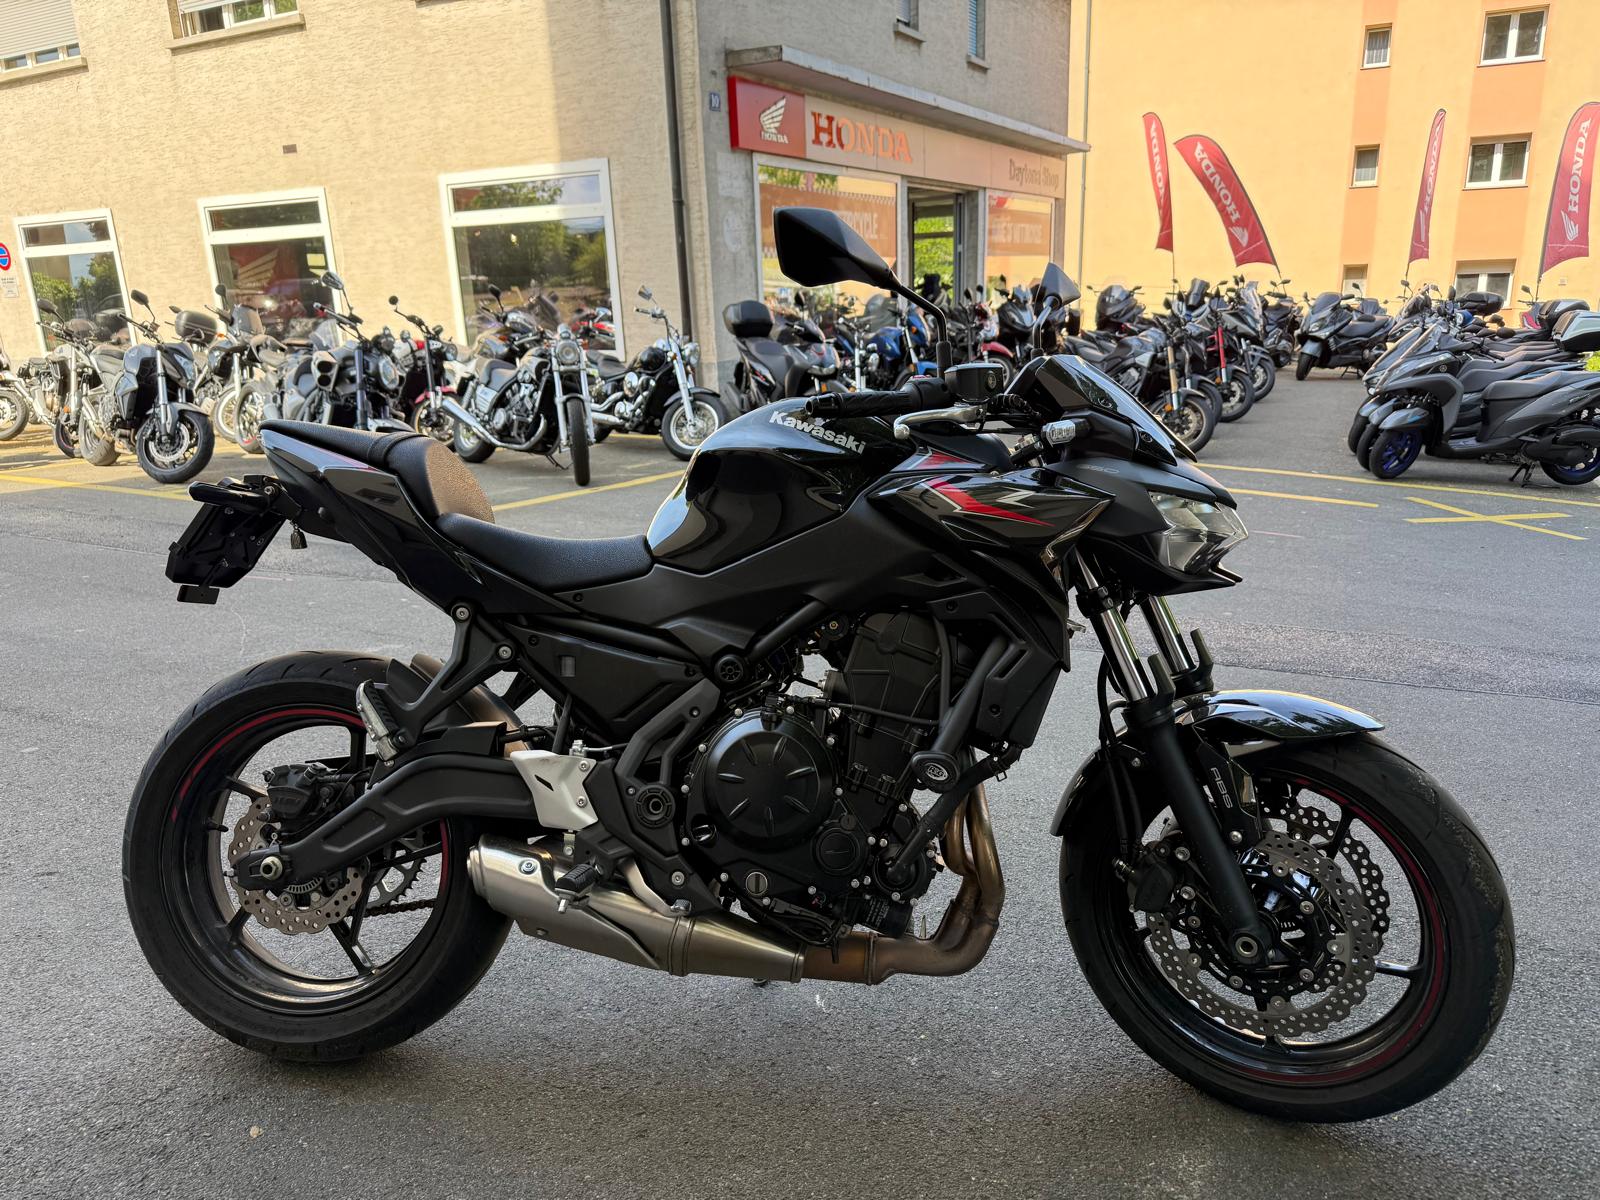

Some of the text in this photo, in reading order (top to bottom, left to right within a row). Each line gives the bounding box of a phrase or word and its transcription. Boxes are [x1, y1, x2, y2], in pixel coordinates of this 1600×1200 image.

[761, 131, 789, 144] HONDA
[811, 111, 913, 164] HONDA
[1194, 141, 1241, 223] HONDA
[1568, 118, 1592, 214] HONDA
[769, 411, 866, 455] Kawasaki
[1210, 767, 1233, 808] ABS
